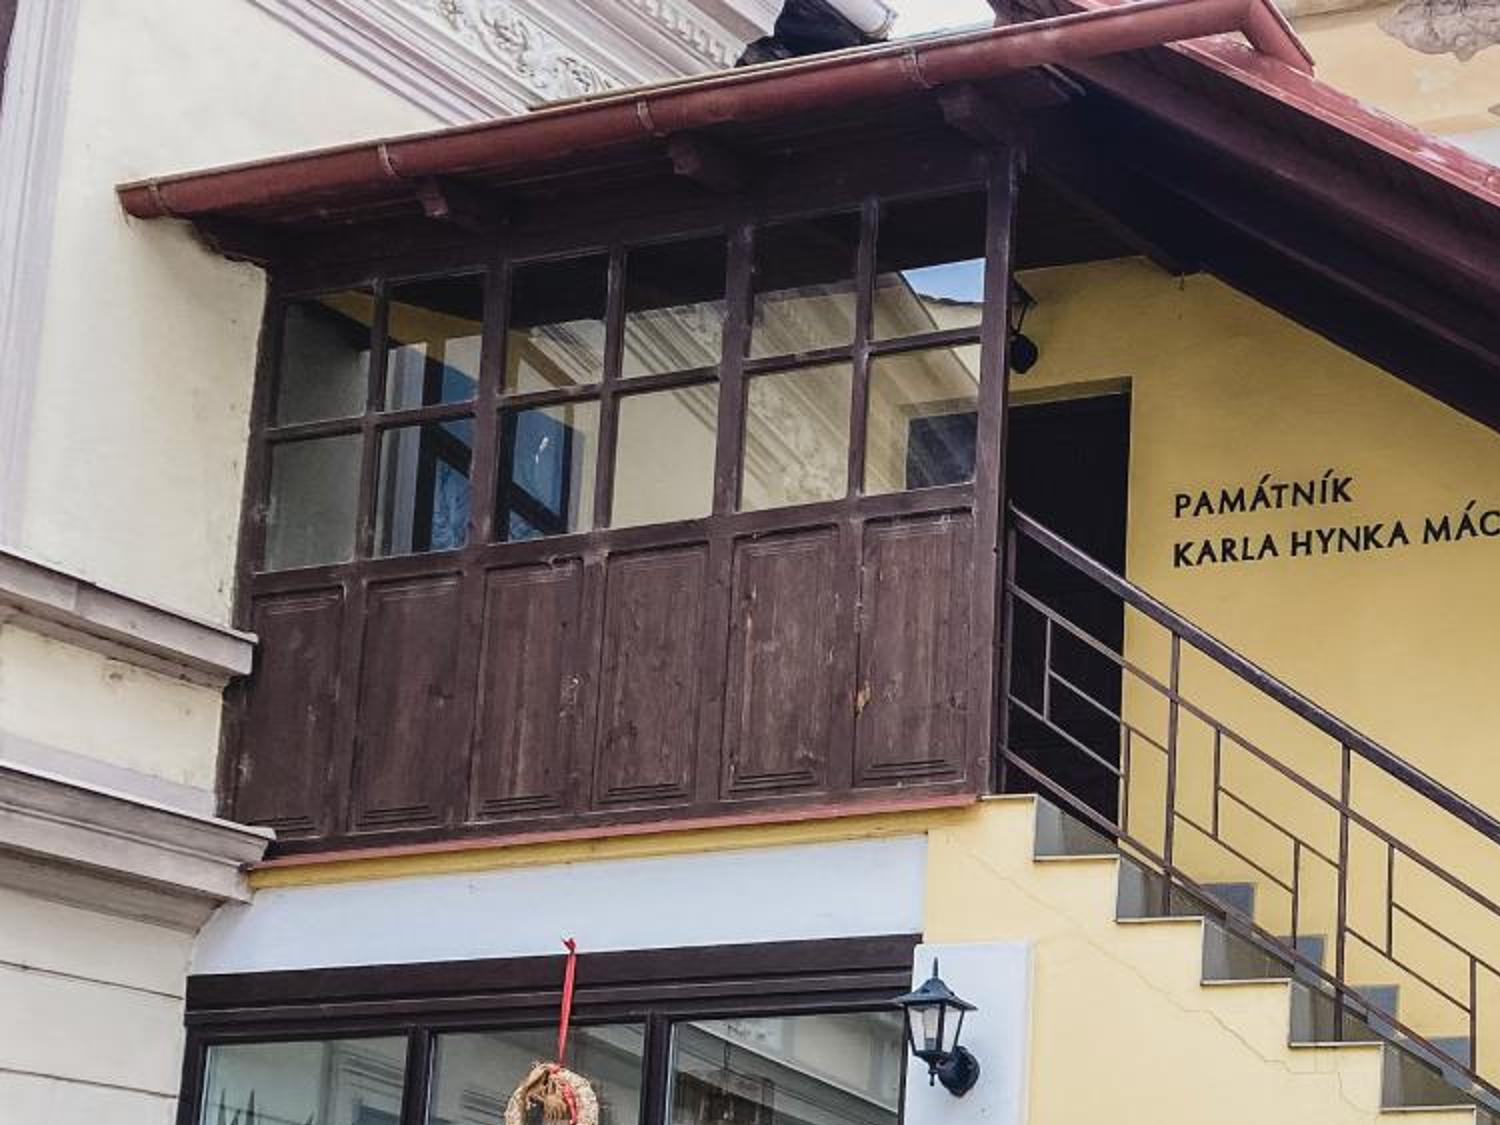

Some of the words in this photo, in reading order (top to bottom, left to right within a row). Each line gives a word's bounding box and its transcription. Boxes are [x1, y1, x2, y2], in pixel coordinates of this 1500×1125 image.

[1174, 468, 1354, 518] PAMÁTNÍK
[1173, 533, 1279, 567] KARLA
[1290, 521, 1409, 556] HYNKA
